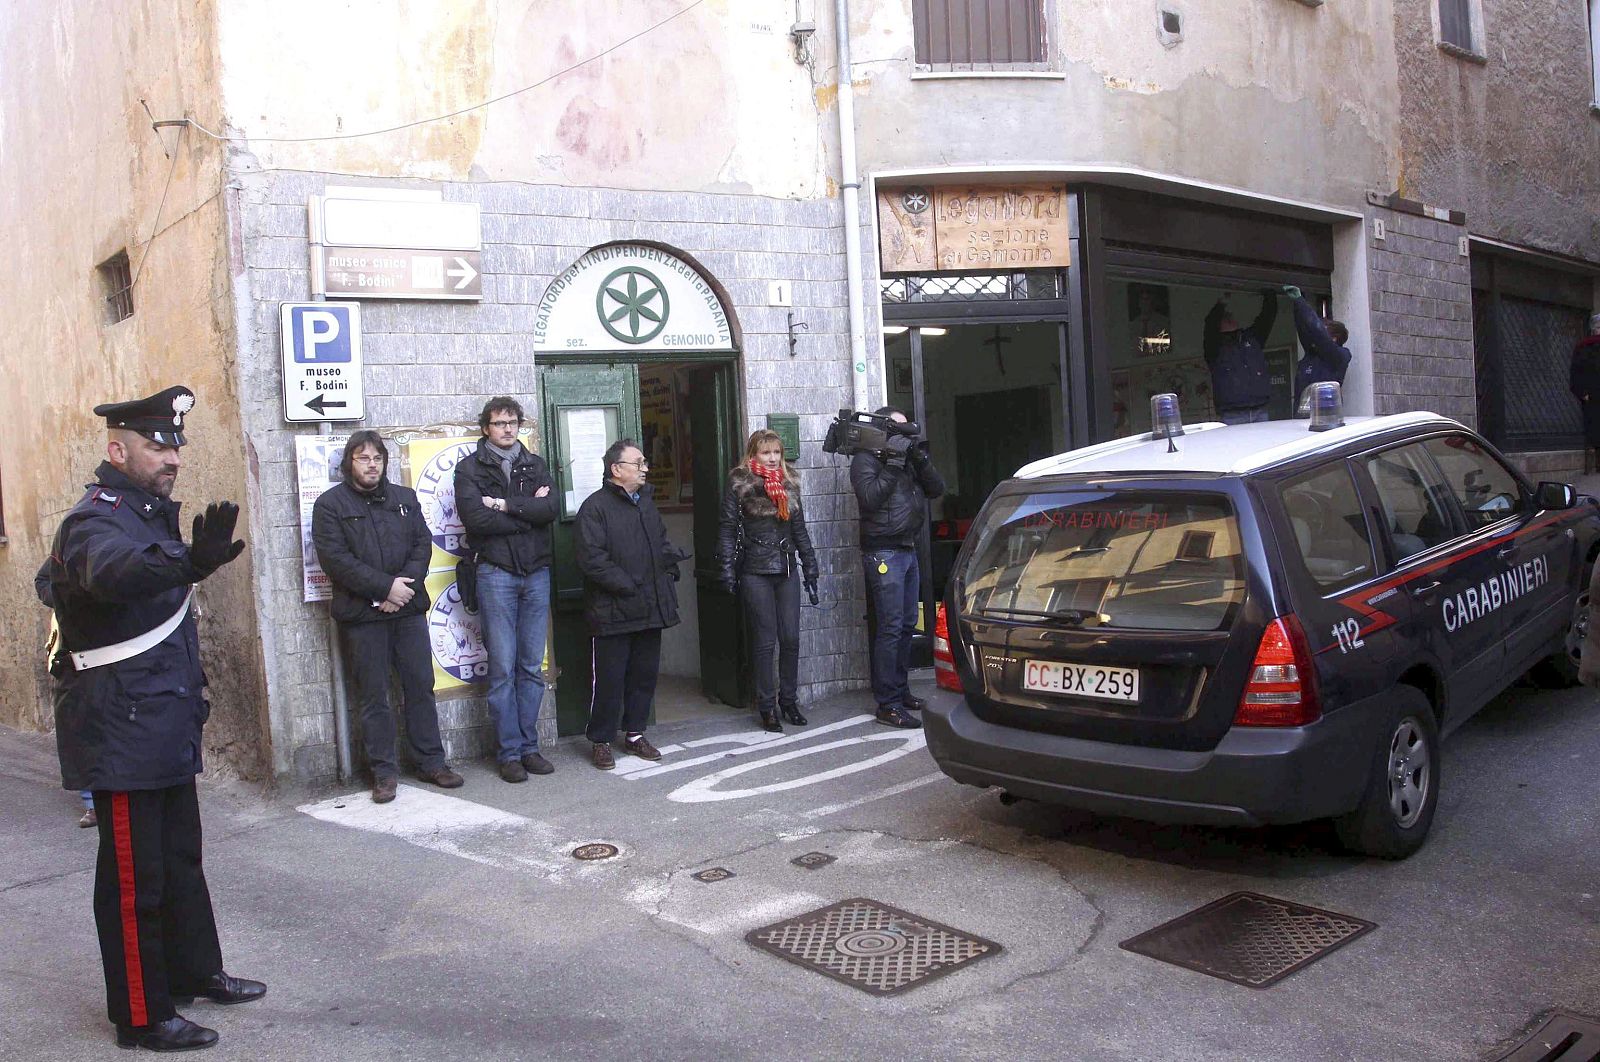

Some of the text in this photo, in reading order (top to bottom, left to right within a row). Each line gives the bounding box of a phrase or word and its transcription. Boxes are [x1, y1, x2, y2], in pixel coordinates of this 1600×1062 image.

[968, 228, 1049, 244] sezione
[328, 256, 407, 267] museo civico
[945, 245, 1052, 265] di Gemonio
[777, 286, 783, 303] 1
[534, 313, 551, 344] LEGA
[543, 279, 566, 312] NORD
[565, 266, 580, 287] per
[677, 264, 703, 291] della
[701, 286, 730, 343] PADANIA
[301, 311, 340, 359] P
[566, 334, 715, 347] sez. GEMONIO
[306, 367, 341, 377] museo
[300, 380, 348, 391] F. Bodini
[1024, 511, 1169, 529] CARABINIERI
[1442, 554, 1548, 633] CARABINIERI
[1331, 617, 1365, 654] 112
[1027, 663, 1135, 696] CC BX 259
